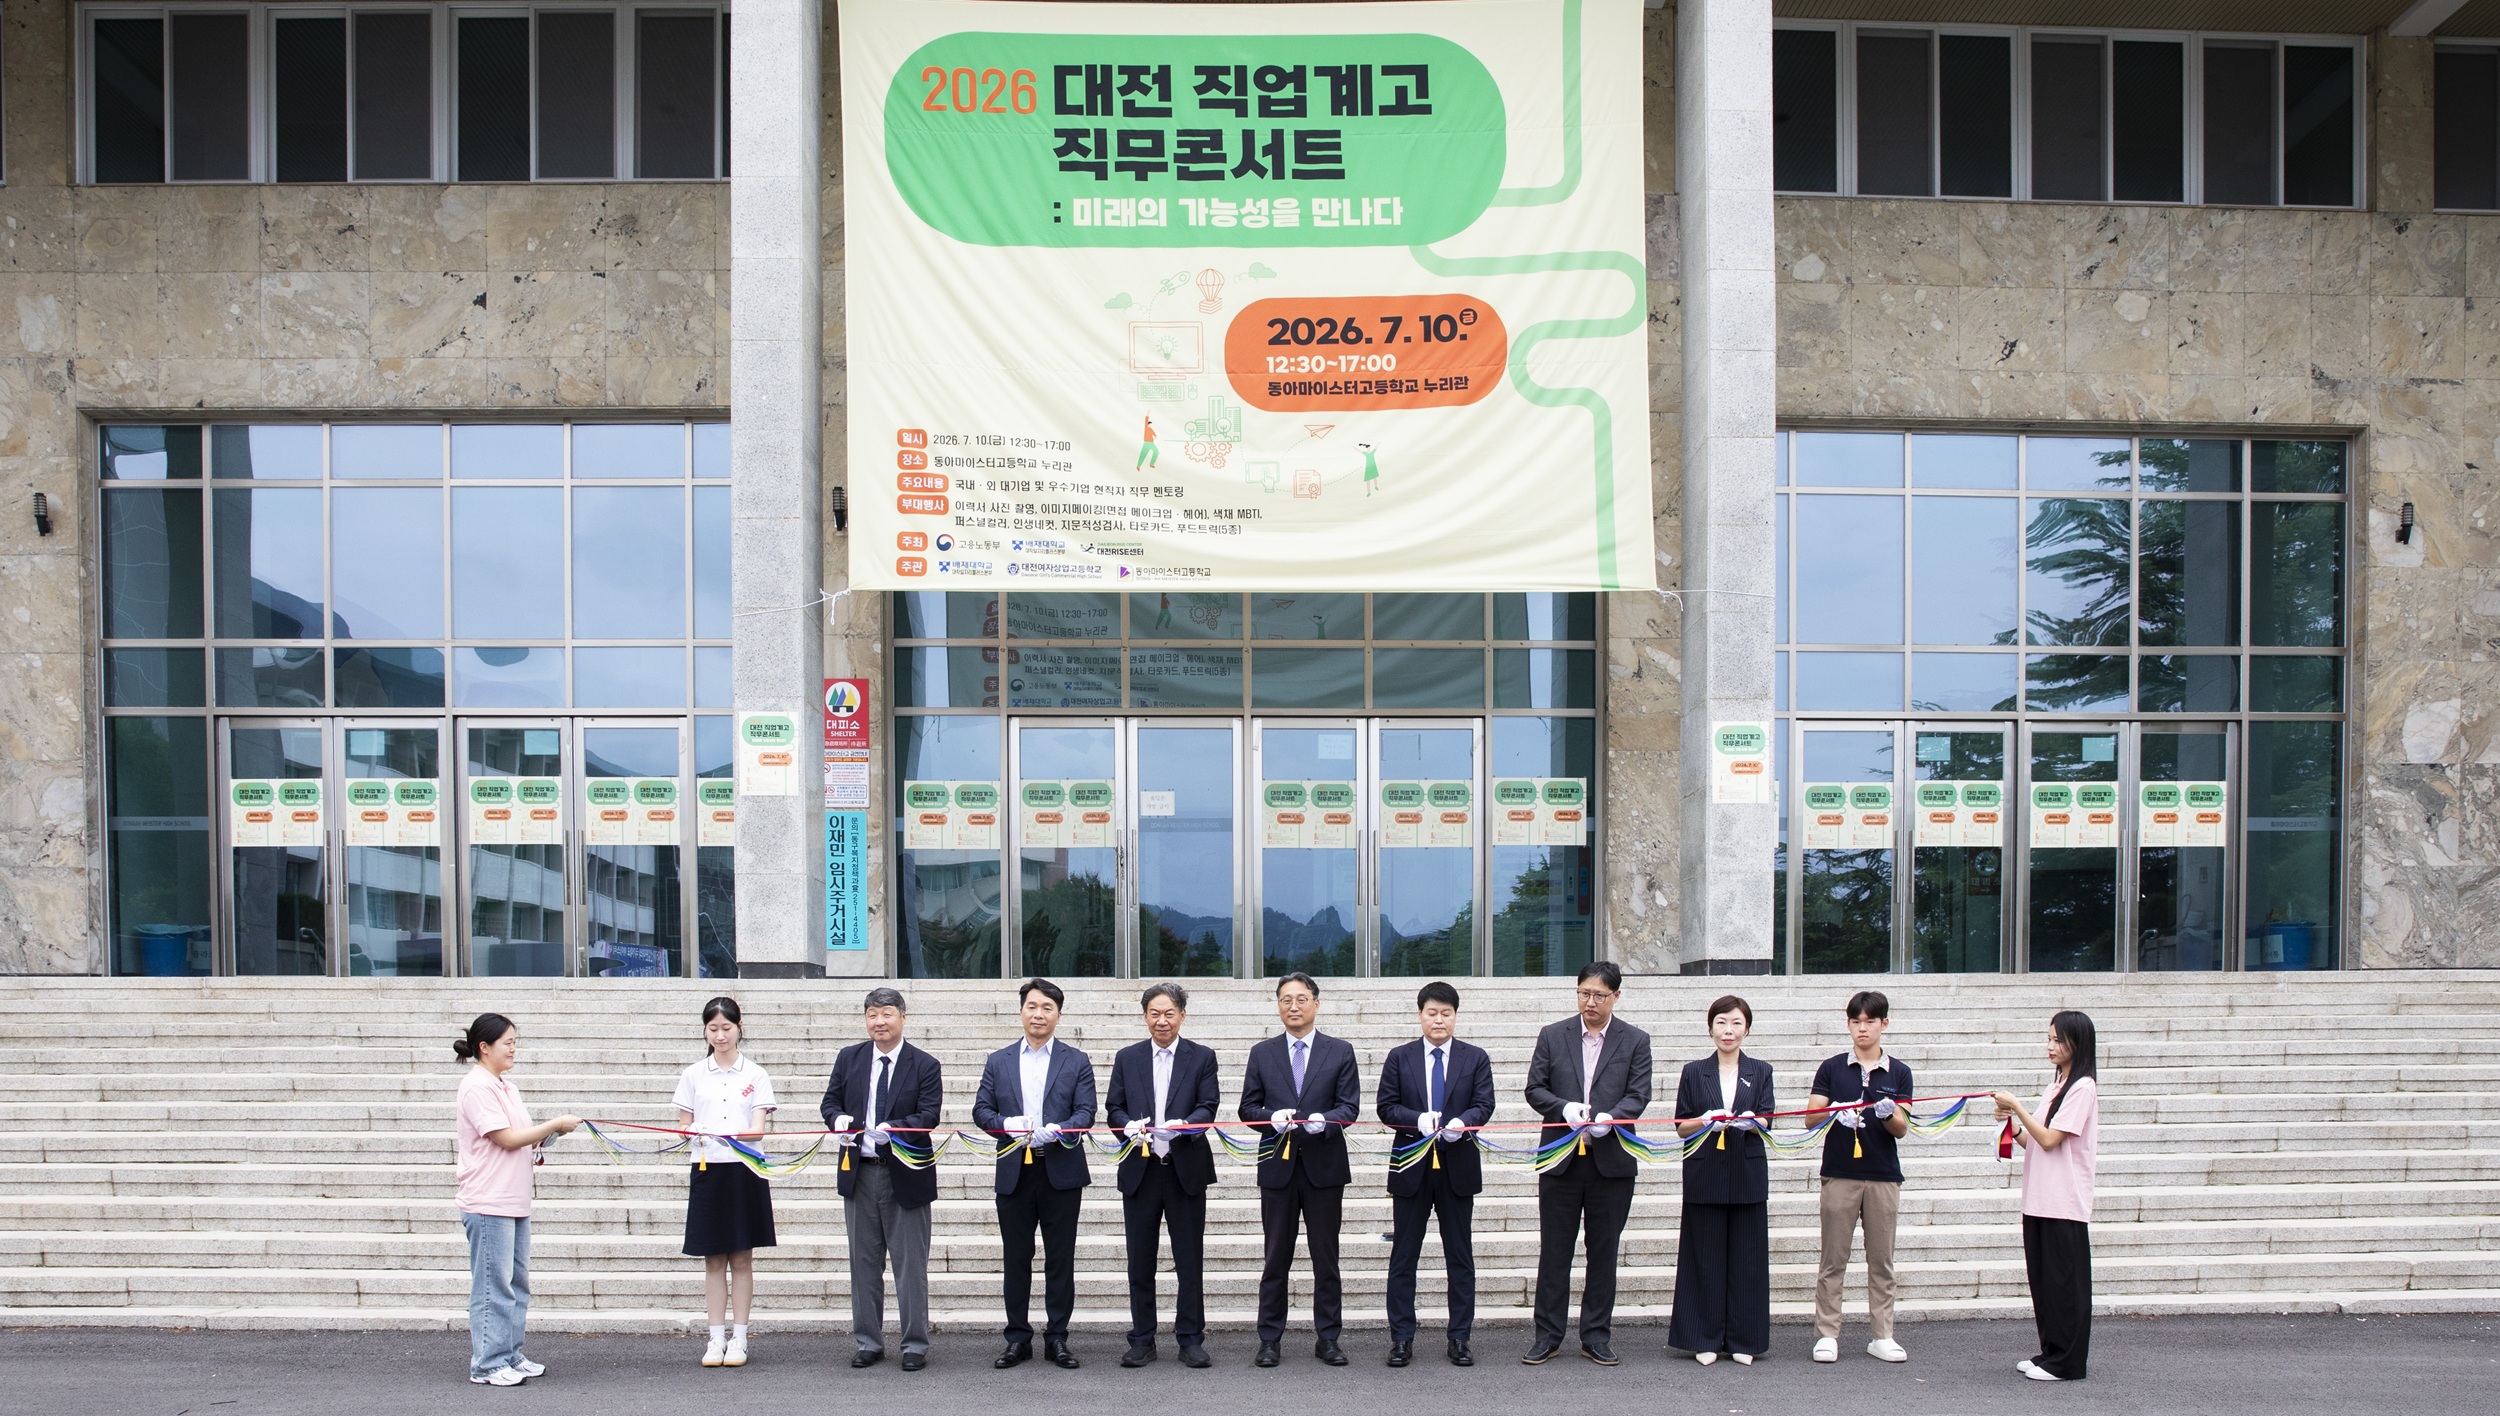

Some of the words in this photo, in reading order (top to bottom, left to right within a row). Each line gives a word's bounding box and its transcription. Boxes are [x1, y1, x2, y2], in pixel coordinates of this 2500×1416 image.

[921, 66, 1038, 114] 2026
[1053, 64, 1173, 118] 대전
[1192, 64, 1432, 118] 직업계고
[1052, 128, 1346, 181] 직무콘서트
[1054, 202, 1061, 223] :
[1074, 197, 1168, 227] 미래의
[1179, 197, 1302, 228] 가능성을
[1312, 196, 1404, 227] 만나다
[1267, 317, 1373, 346] 2026.
[1380, 316, 1412, 344] 7.
[1419, 314, 1468, 342] 10.
[1460, 310, 1476, 324] 금
[1266, 354, 1396, 374] 12:30~17:00
[1268, 378, 1419, 396] 동아마이스터고등학교
[1424, 376, 1469, 392] 누리관
[902, 432, 922, 445] 일시
[933, 434, 960, 446] 2026.
[964, 436, 971, 445] 7.
[1010, 438, 1070, 451] 12:30~17:00
[902, 454, 922, 466] 장소
[934, 456, 1037, 468] 동아마이스터고등학교
[1041, 460, 1072, 472] 누리관
[902, 476, 944, 489] 주요내용
[955, 480, 975, 491] 국내
[986, 480, 996, 492] 외
[1001, 481, 1030, 492] 대기업
[1035, 481, 1044, 492] 및
[1048, 481, 1090, 494] 우수기업
[1094, 486, 1125, 496] 현직자
[1130, 486, 1149, 497] 직무
[1154, 486, 1184, 498] 멘토링
[902, 498, 944, 511] 부대행사
[955, 500, 986, 512] 이력서
[990, 502, 1010, 513] 사진
[1014, 502, 1038, 515] 촬영,
[1041, 503, 1126, 516] 이미지메이킹(면접
[1131, 507, 1172, 518] 메이크업
[1184, 508, 1210, 520] 헤어),
[1213, 508, 1234, 520] 색채
[1238, 509, 1262, 520] MBTI,
[955, 516, 1010, 529] 퍼스널컬러,
[1014, 518, 1058, 530] 인생네컷,
[1061, 520, 1126, 532] 지문적성검사,
[1130, 522, 1174, 533] 타로카드,
[1177, 524, 1242, 535] 푸드트럭(5종)
[902, 536, 923, 548] 주최
[958, 540, 1000, 550] 고용노동부
[1025, 540, 1065, 548] 배재대학교
[1097, 548, 1144, 556] 대전RISE센터
[902, 561, 923, 572] 주관
[952, 561, 993, 569] 배재대학교
[1022, 563, 1102, 573] 대전여자상업고등학교
[1136, 567, 1211, 576] 동아마이스터고등학교
[1049, 654, 1063, 664] 사진
[1150, 654, 1179, 663] 메이크업
[826, 720, 860, 729] 대피소
[829, 816, 845, 857] 이재민
[830, 862, 846, 945] 임시주거시설
